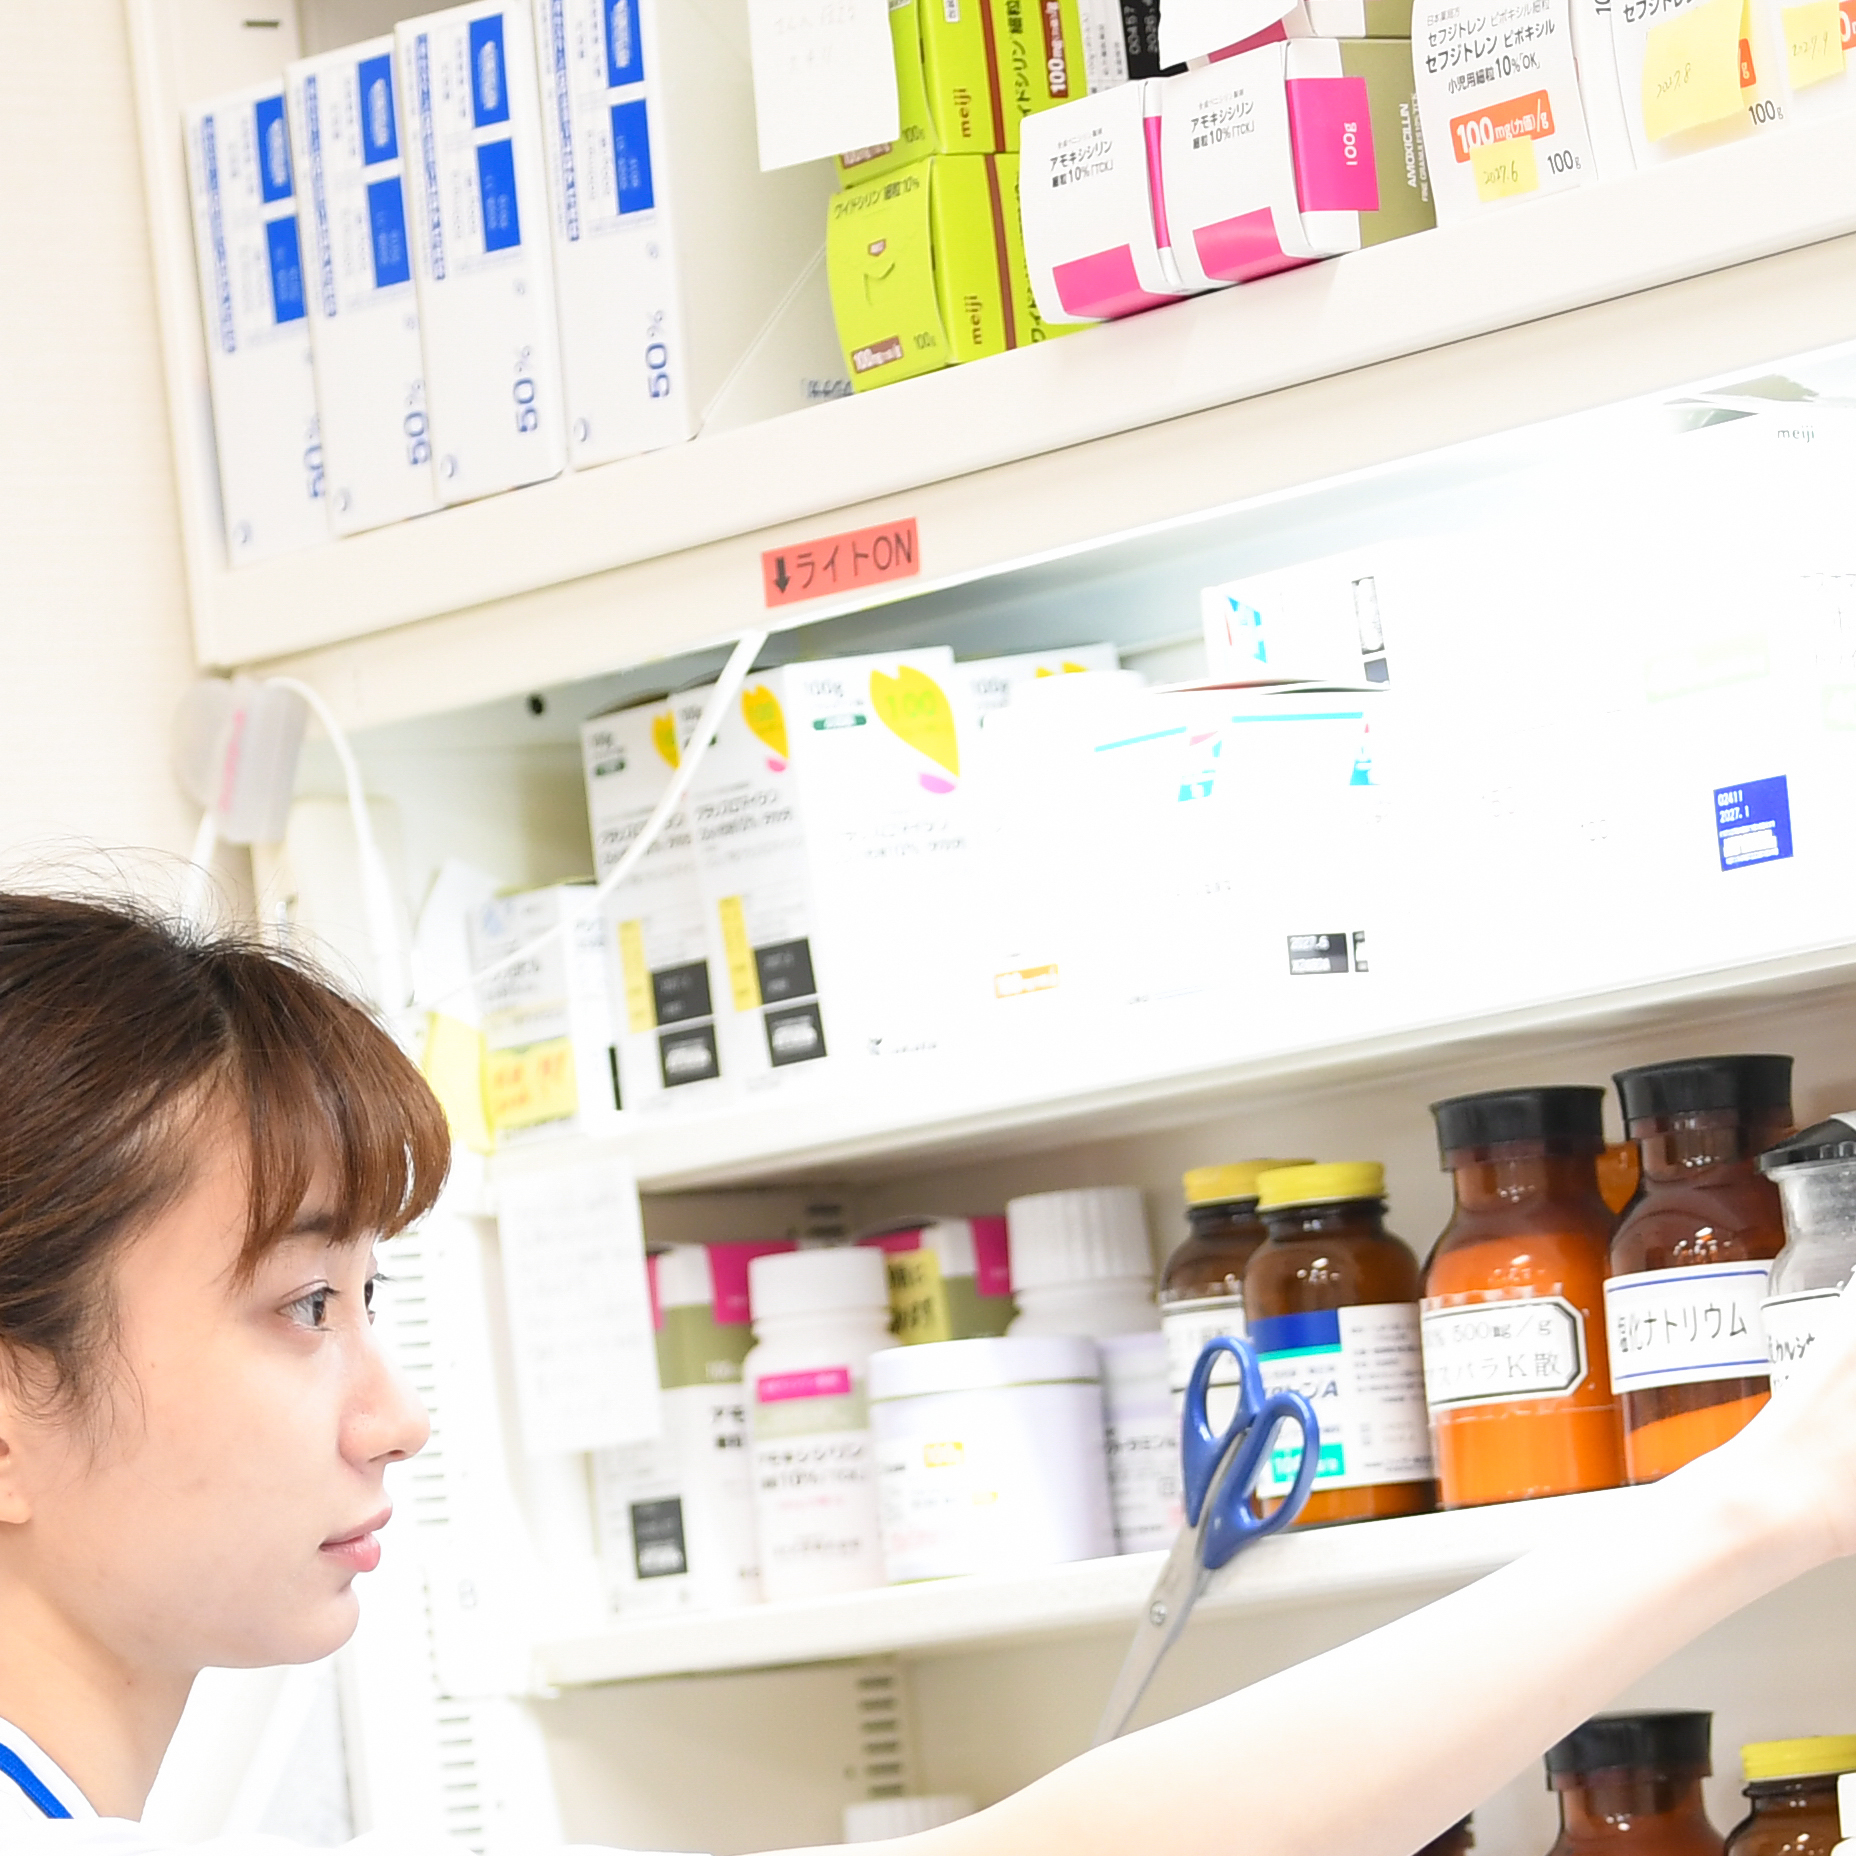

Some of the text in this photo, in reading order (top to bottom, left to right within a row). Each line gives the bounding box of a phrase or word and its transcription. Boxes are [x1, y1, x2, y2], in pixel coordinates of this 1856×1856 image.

[1425, 19, 1555, 75] セフジトレン ピボキシル
[1427, 16, 1486, 47] セフジトレン
[954, 87, 972, 138] meiji
[1190, 100, 1254, 132] アモキシシリン
[1748, 100, 1784, 126] 100g
[1050, 139, 1113, 171] アモキシシリン
[1344, 122, 1359, 166] 100g
[1399, 103, 1417, 188] AMOXICILLIN
[1547, 150, 1581, 176] 100g
[964, 294, 983, 345] meiji
[646, 309, 669, 399] 50%
[514, 344, 539, 433] 50%
[794, 529, 914, 590] ライトON
